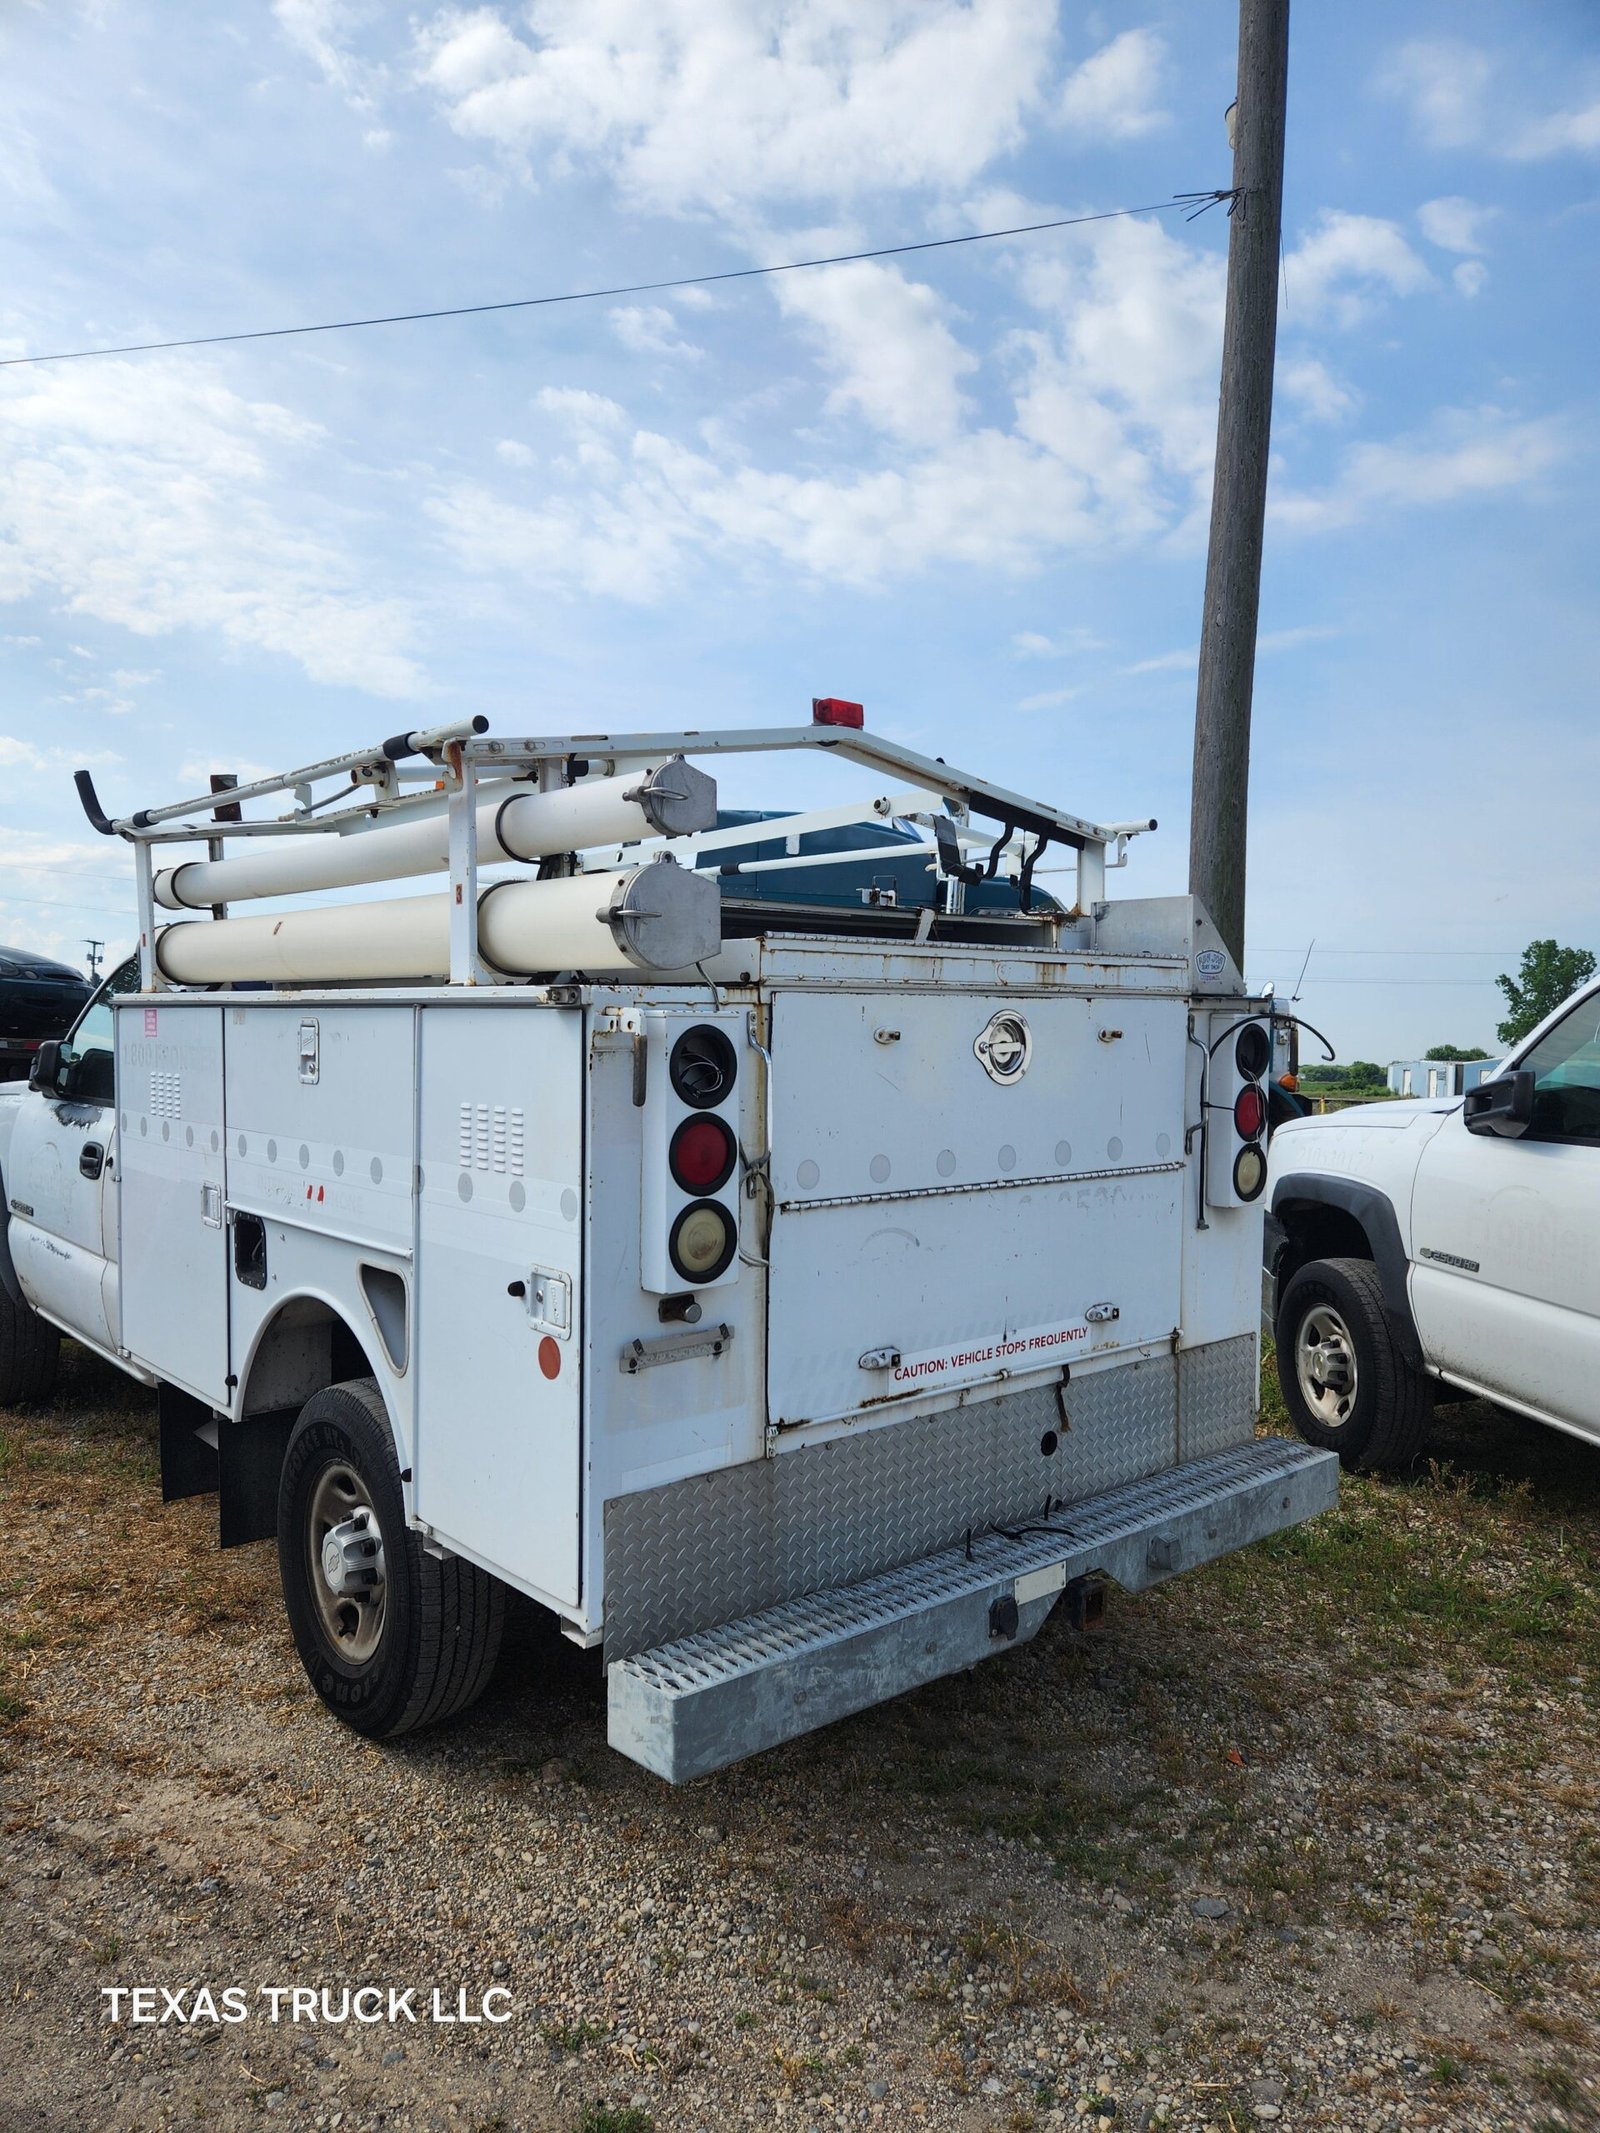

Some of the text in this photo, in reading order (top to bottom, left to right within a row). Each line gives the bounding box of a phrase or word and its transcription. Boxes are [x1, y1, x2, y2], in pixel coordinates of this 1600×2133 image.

[1433, 1251, 1477, 1271] 2500 HD
[894, 1327, 1089, 1381] CAUTION: VEHICLE STOPS FREQUENTLY
